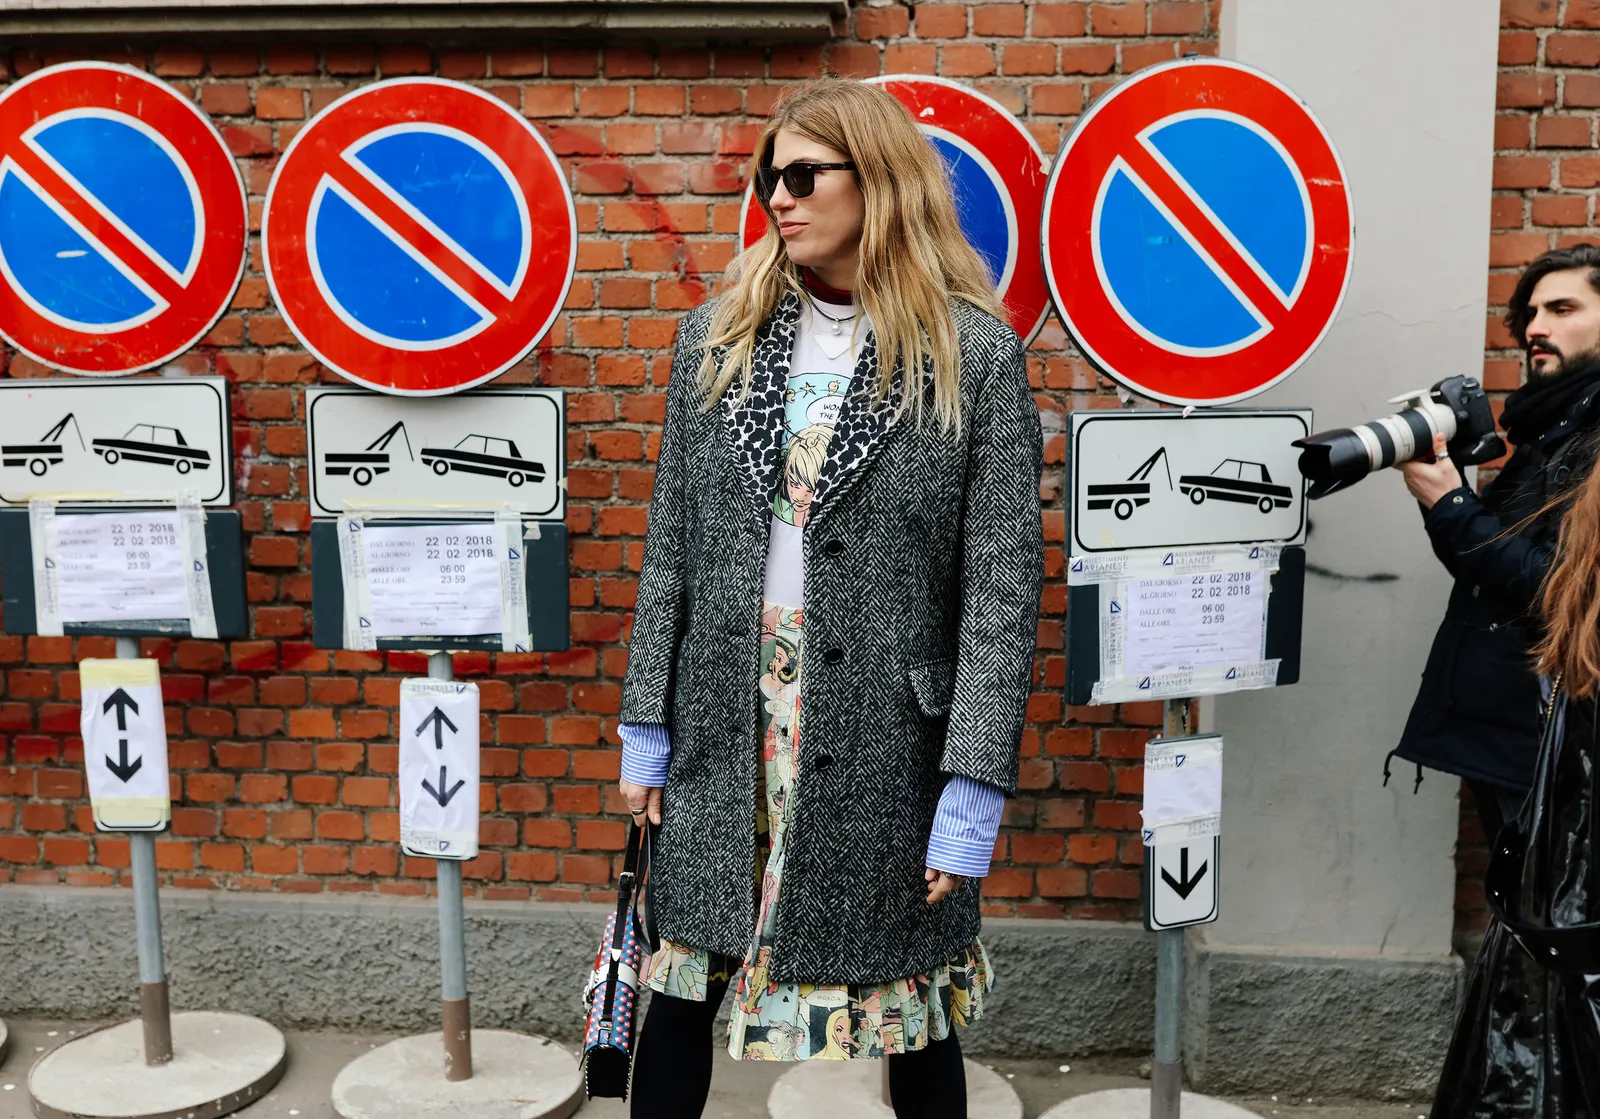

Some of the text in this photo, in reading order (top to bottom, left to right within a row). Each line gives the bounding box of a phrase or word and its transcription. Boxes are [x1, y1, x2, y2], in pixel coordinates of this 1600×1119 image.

[819, 412, 834, 420] THE
[111, 523, 174, 534] 22 02 2018
[113, 536, 176, 546] 22 02 2018
[426, 537, 439, 546] 22
[446, 536, 459, 546] 02
[466, 536, 492, 546] 2018
[427, 549, 440, 559] 22
[446, 548, 460, 558] 02
[467, 548, 494, 558] 2018
[1174, 556, 1216, 566] ARIANESE
[1084, 562, 1128, 572] ARIANESE
[1154, 579, 1182, 587] GIORNO
[1192, 576, 1204, 585] 22
[1210, 574, 1222, 584] 02
[1228, 572, 1251, 582] 2018
[1150, 591, 1177, 600] GIORNO
[1192, 588, 1204, 598] 22
[1210, 587, 1222, 598] 02
[1228, 586, 1250, 596] 2018
[1236, 668, 1276, 679] ARIANESE
[1151, 678, 1193, 689] ARIANESE
